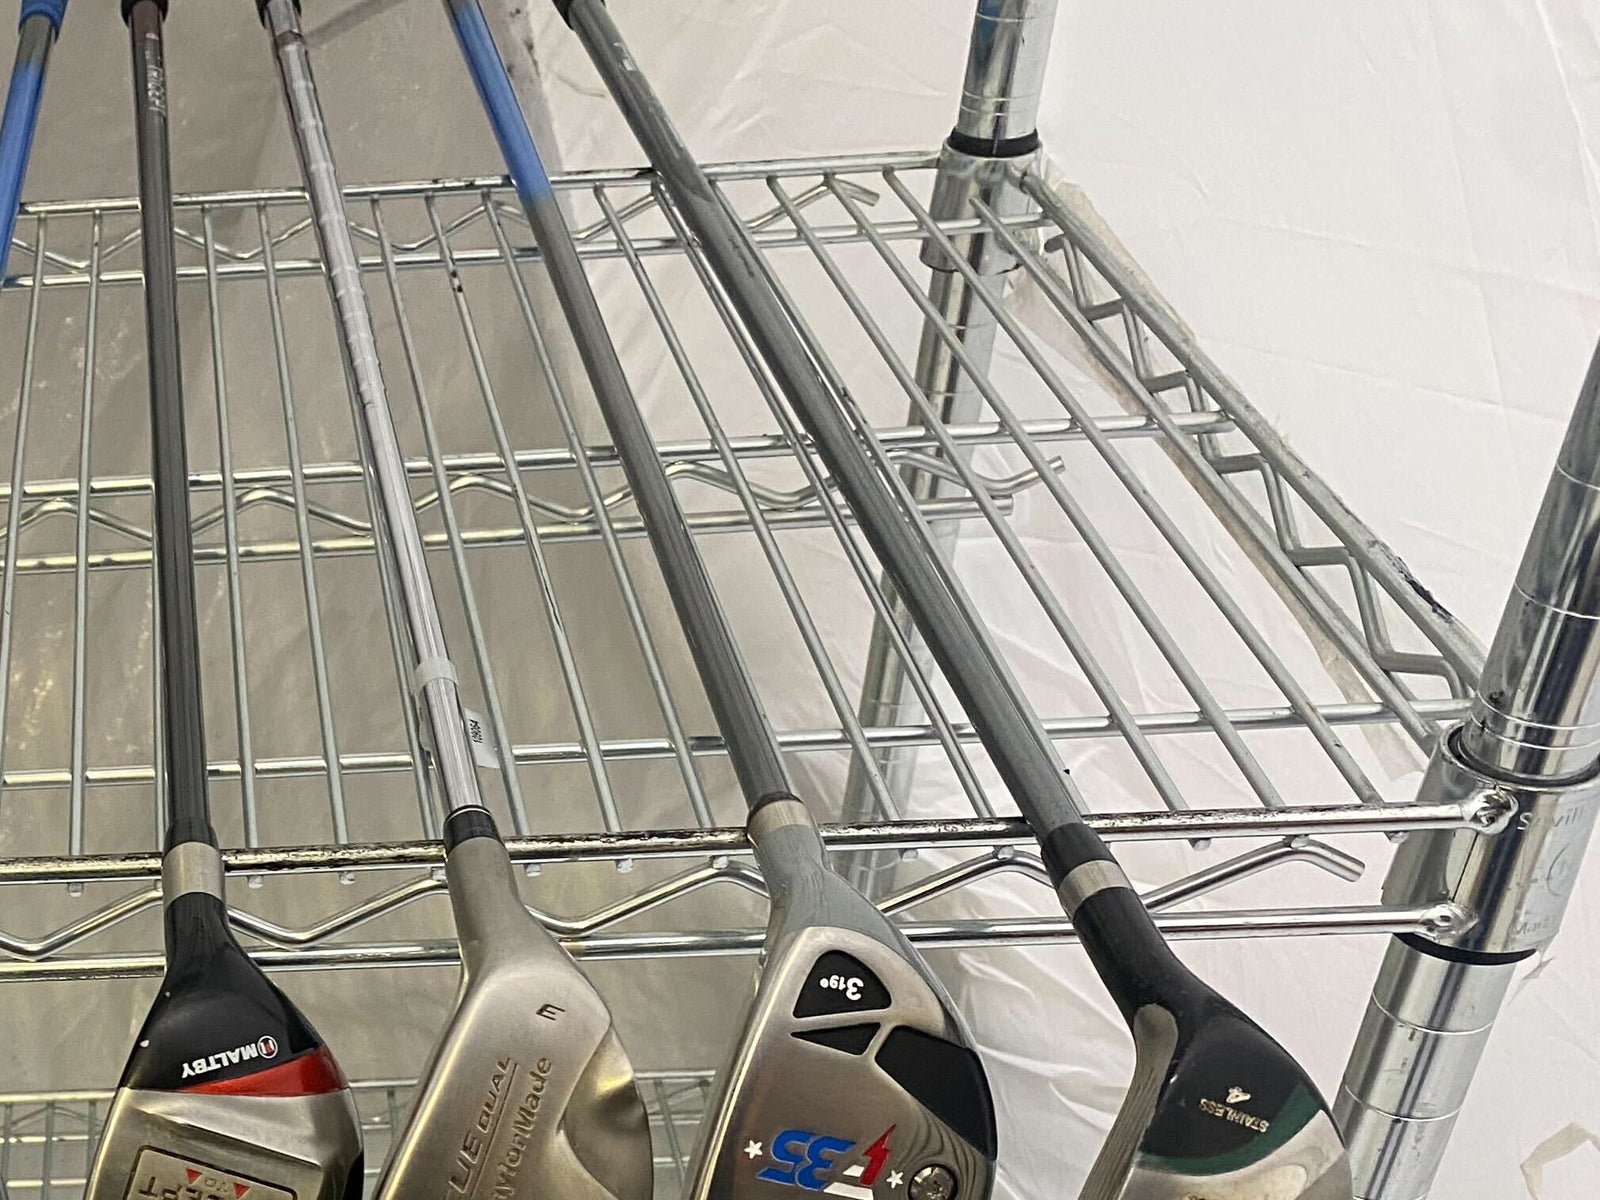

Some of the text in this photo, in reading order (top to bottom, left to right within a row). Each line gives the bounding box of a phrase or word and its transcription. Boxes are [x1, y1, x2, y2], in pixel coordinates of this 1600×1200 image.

[182, 1043, 259, 1079] MALTBY
[477, 1056, 513, 1134] DUAL
[1200, 1098, 1270, 1133] STAINLESS
